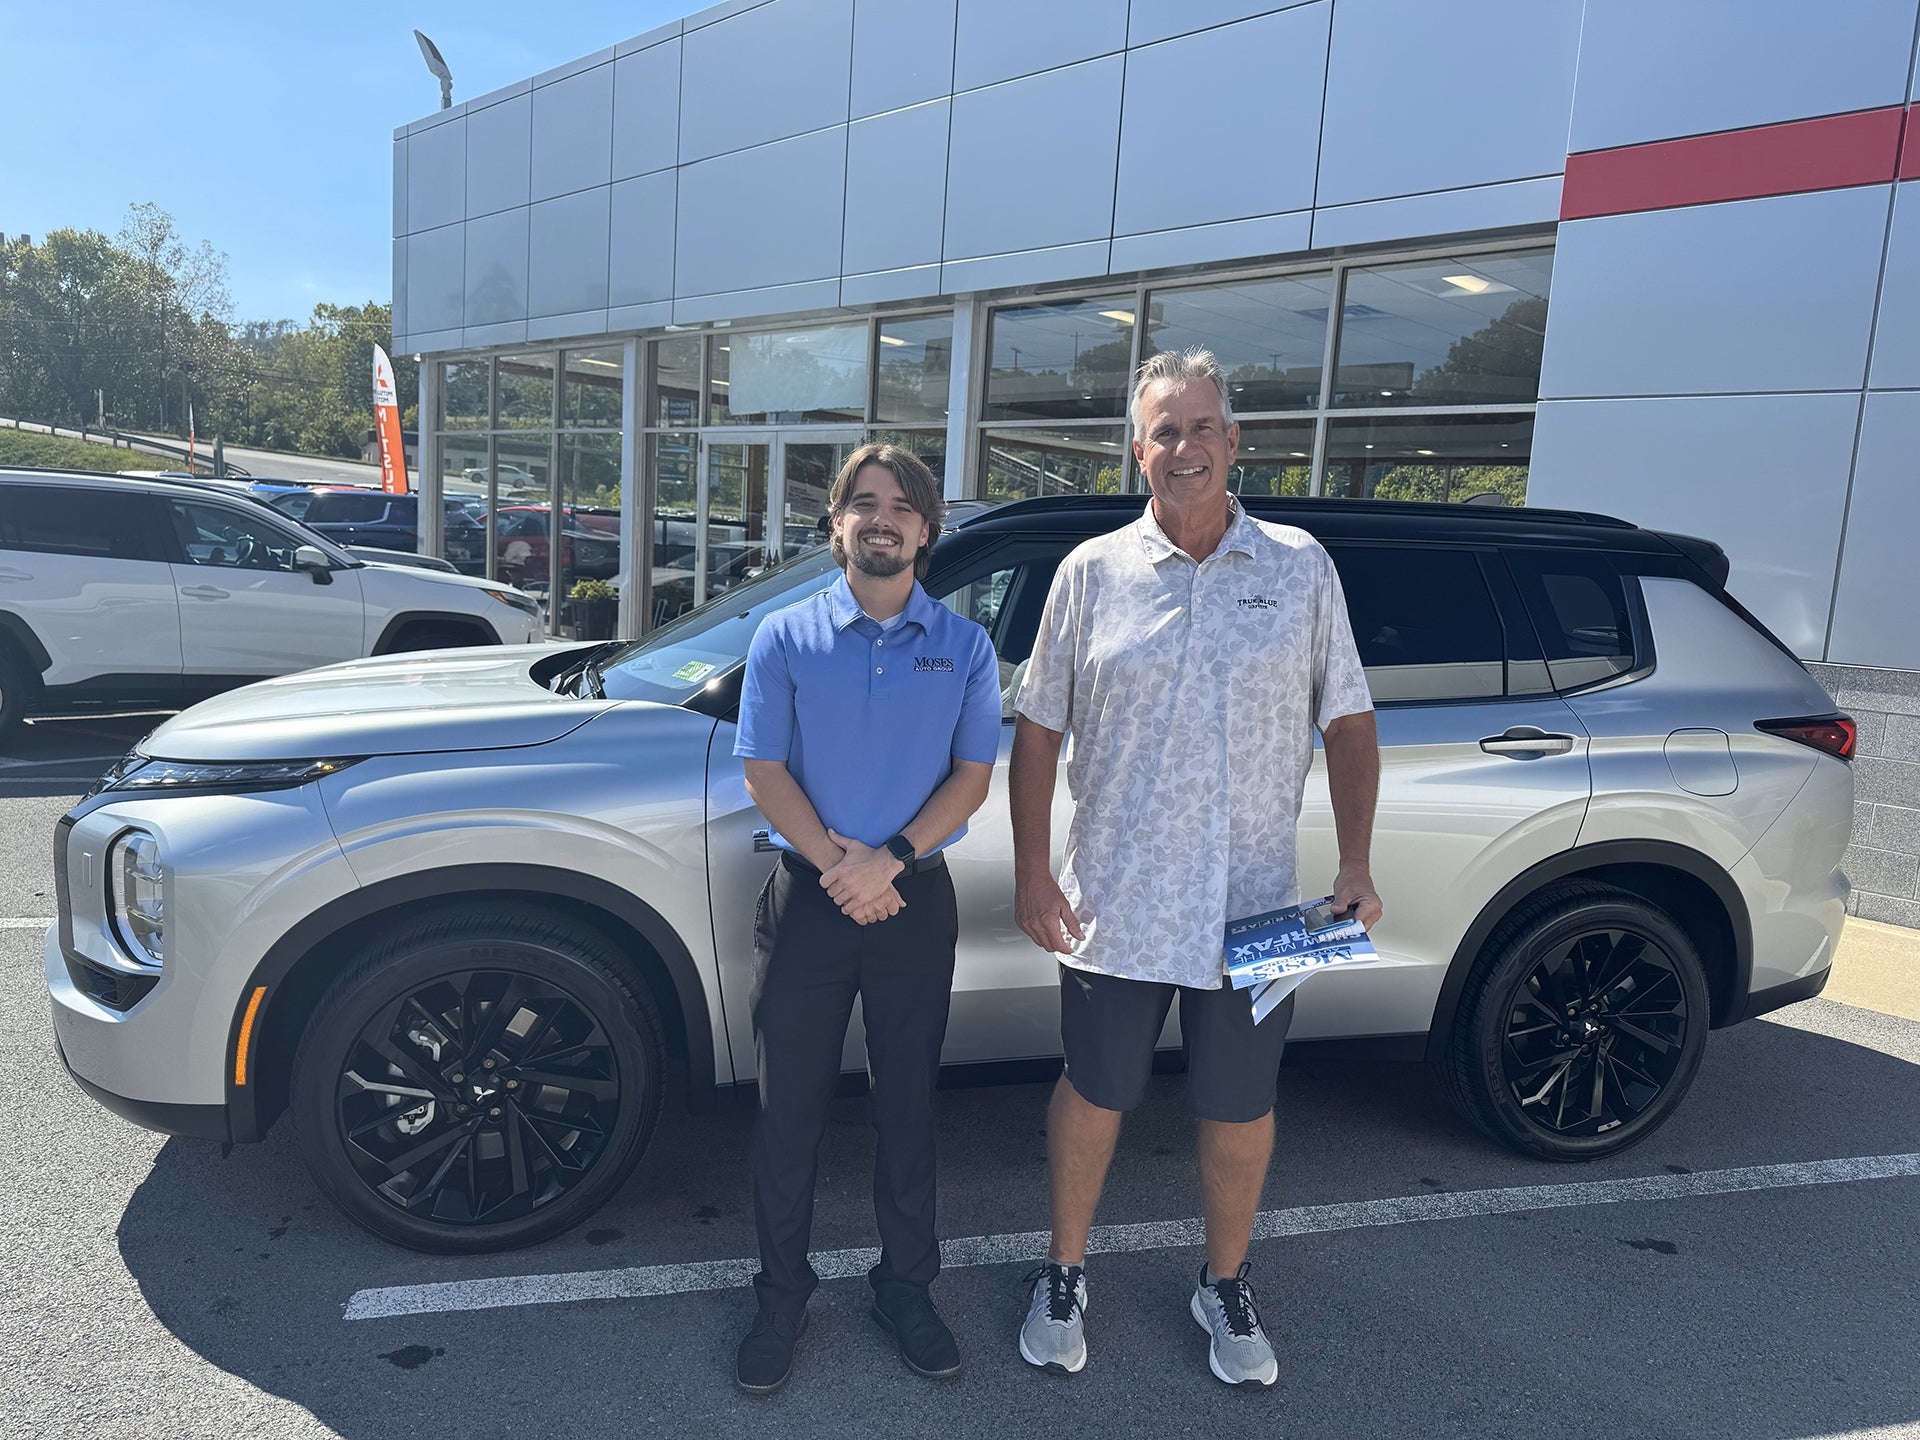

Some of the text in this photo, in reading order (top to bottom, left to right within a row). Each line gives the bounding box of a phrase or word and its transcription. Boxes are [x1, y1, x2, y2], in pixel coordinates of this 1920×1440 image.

[914, 656, 954, 667] MOSES
[1232, 929, 1311, 960] RFAX
[1271, 942, 1297, 956] ME
[1234, 952, 1266, 964] THE
[1253, 948, 1353, 980] MOSES
